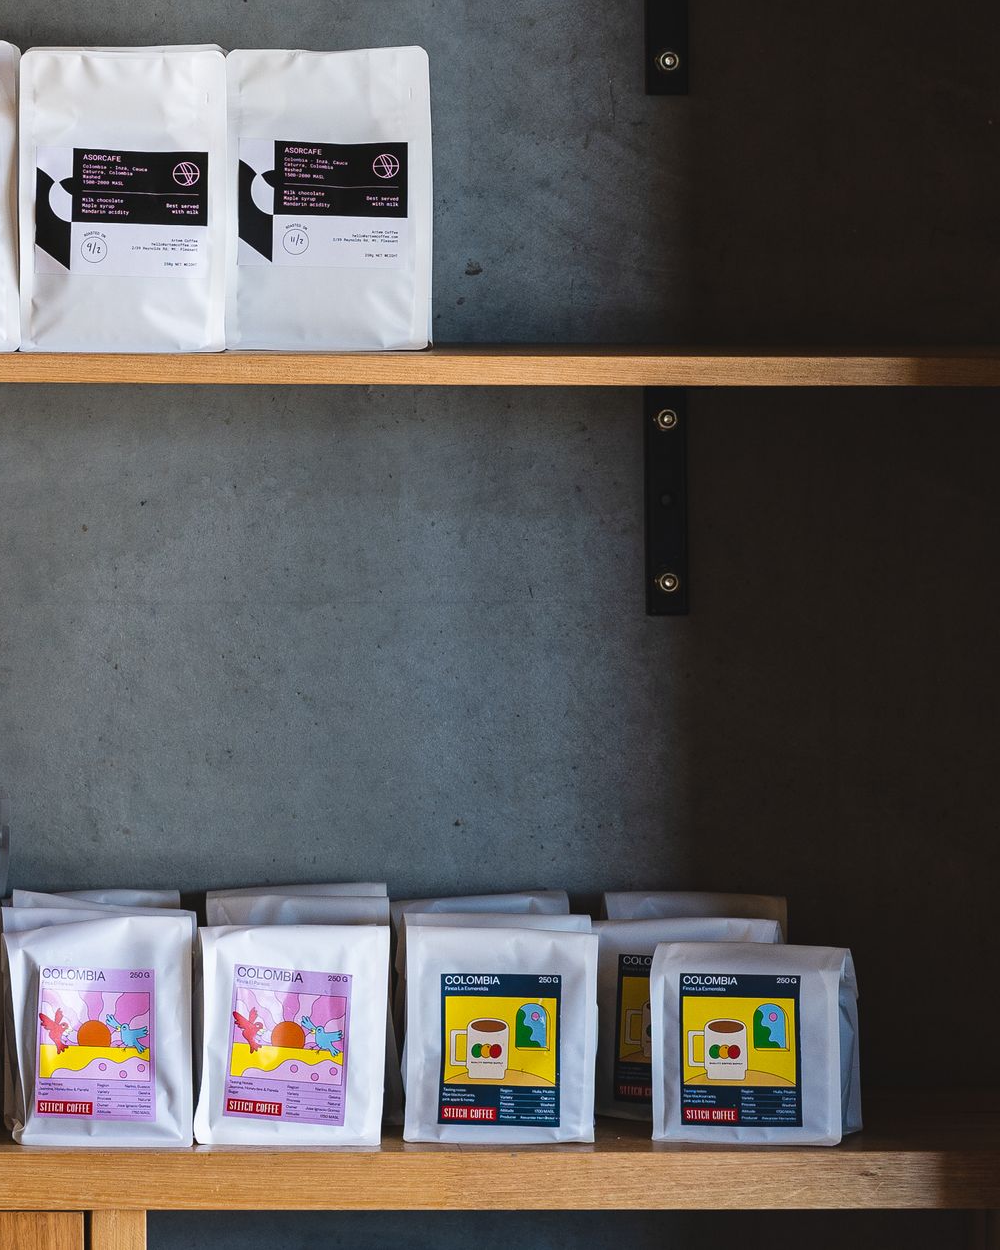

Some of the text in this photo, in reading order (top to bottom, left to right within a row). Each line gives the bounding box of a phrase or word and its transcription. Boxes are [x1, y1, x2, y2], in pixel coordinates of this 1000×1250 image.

[284, 147, 322, 155] ASORCAFE
[83, 154, 121, 162] ASORCAFE
[86, 242, 101, 254] 9/2
[42, 968, 106, 982] COLOMBIA
[129, 971, 143, 979] 250
[237, 966, 304, 984] COLOMBIA
[327, 975, 341, 983] 250
[445, 975, 500, 985] COLOMBIA
[538, 976, 552, 984] 250
[683, 975, 738, 986] COLOMBIA
[40, 1102, 91, 1114] STITCH COFFEE
[229, 1100, 280, 1114] STITCH COFFEE
[444, 1107, 494, 1119] STITCH COFFEE
[686, 1109, 736, 1121] STITCH COFFEE
